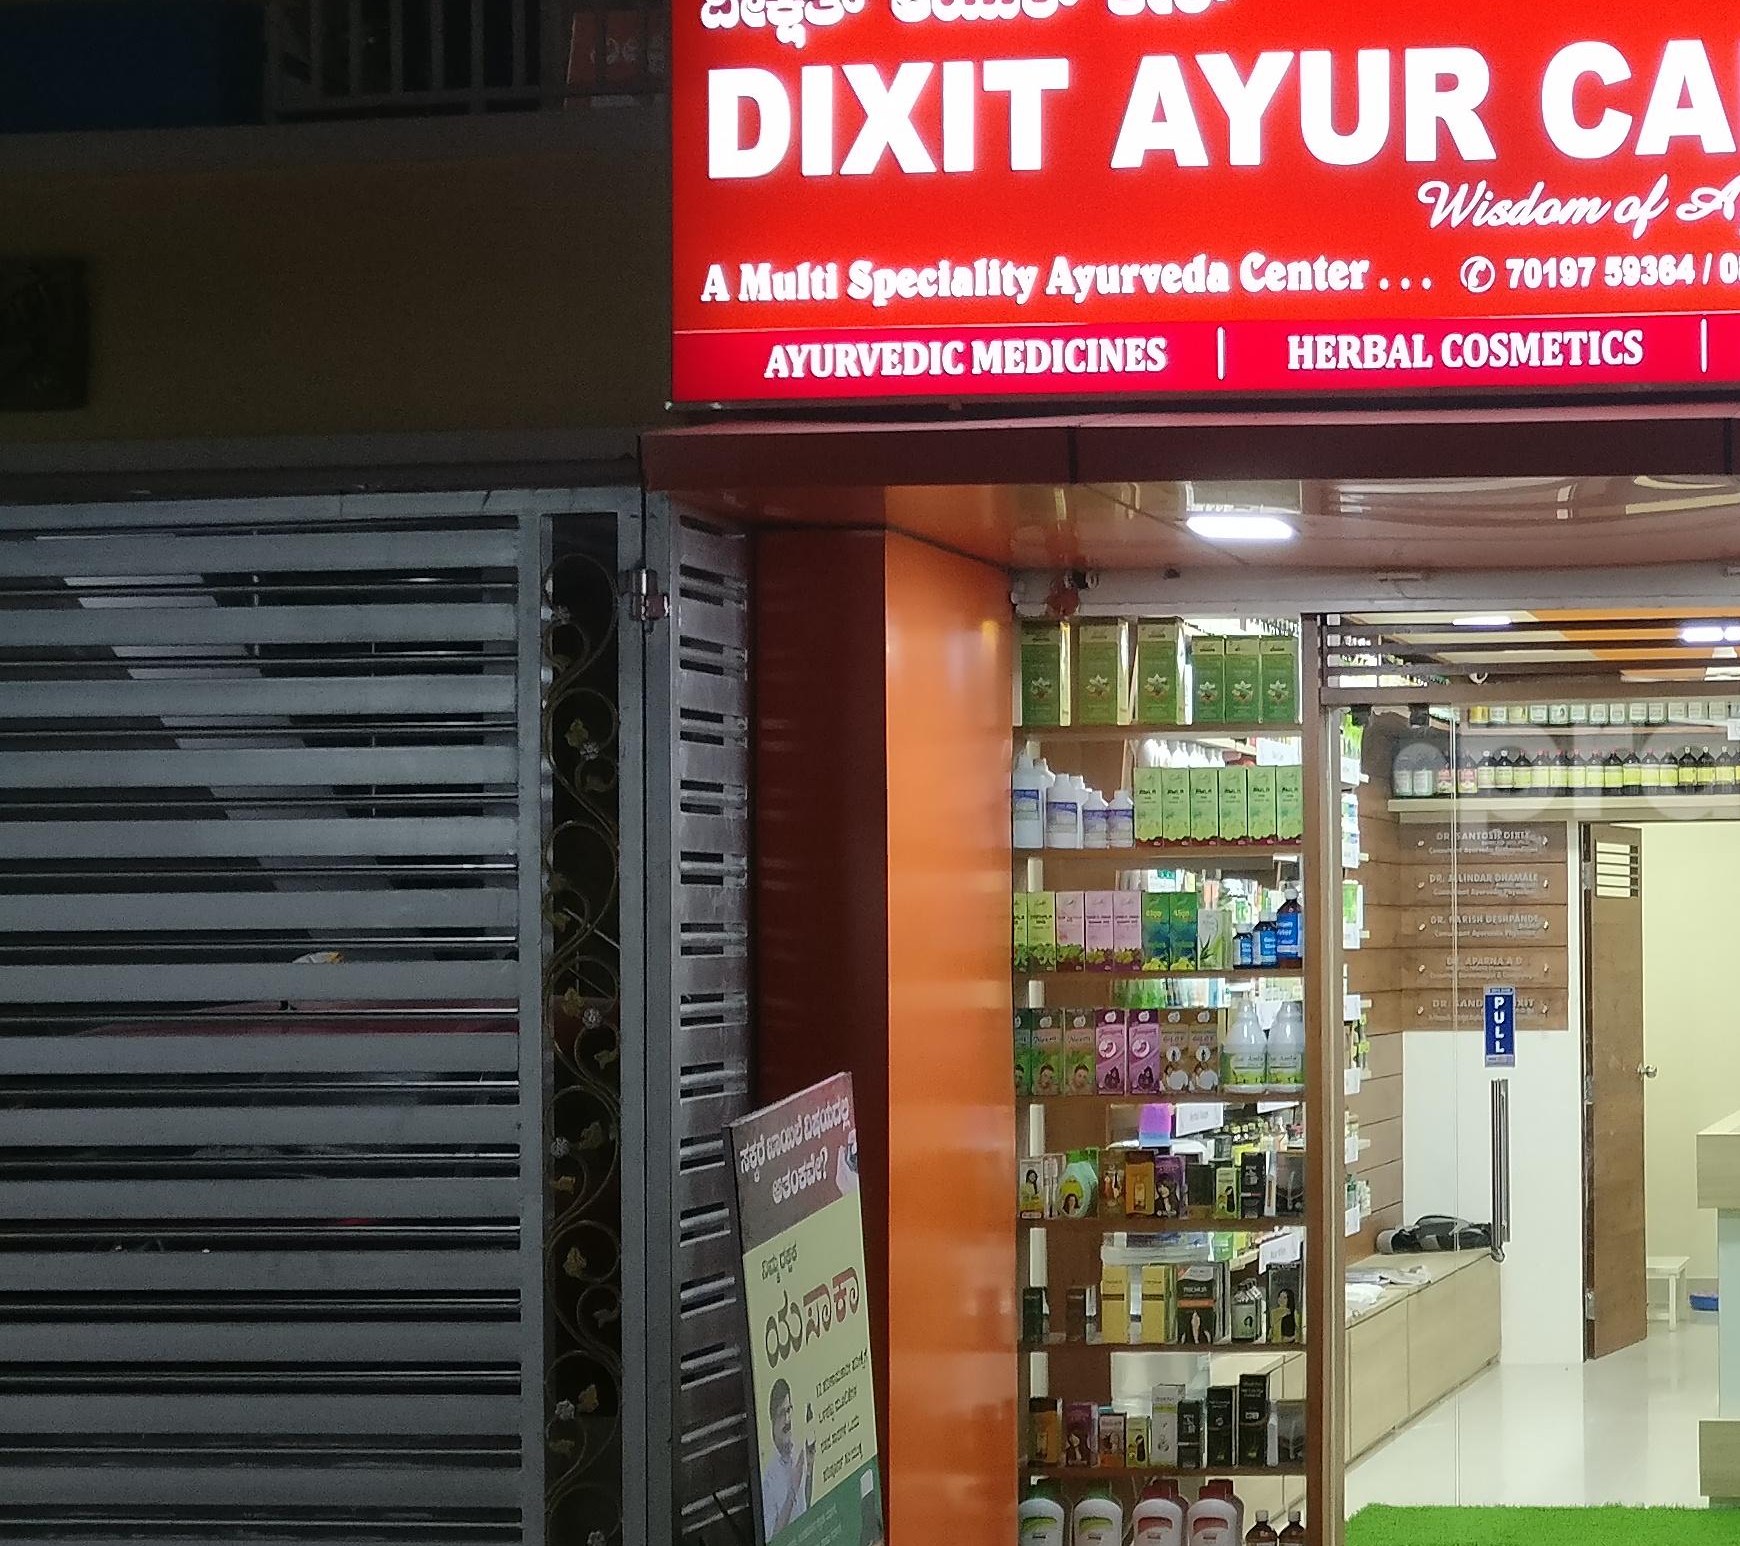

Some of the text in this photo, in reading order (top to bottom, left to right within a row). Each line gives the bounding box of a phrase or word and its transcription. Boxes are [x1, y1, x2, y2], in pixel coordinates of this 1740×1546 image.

[708, 58, 1069, 179] DIXIT
[1110, 47, 1497, 169] AYUR
[1417, 179, 1610, 229] Wisdom
[1612, 173, 1669, 240] of
[700, 273, 731, 302] A
[738, 262, 839, 302] Multi
[846, 258, 1039, 307] Speciality
[1045, 254, 1232, 304] Ayurveda
[1239, 251, 1370, 293] Center
[1505, 256, 1597, 289] 70197
[1603, 253, 1696, 287] 59364
[763, 337, 1167, 379] AYURVEDIC MEDICINES
[1287, 329, 1643, 370] HERBAL COSMETICS
[1493, 996, 1505, 1053] PULL
